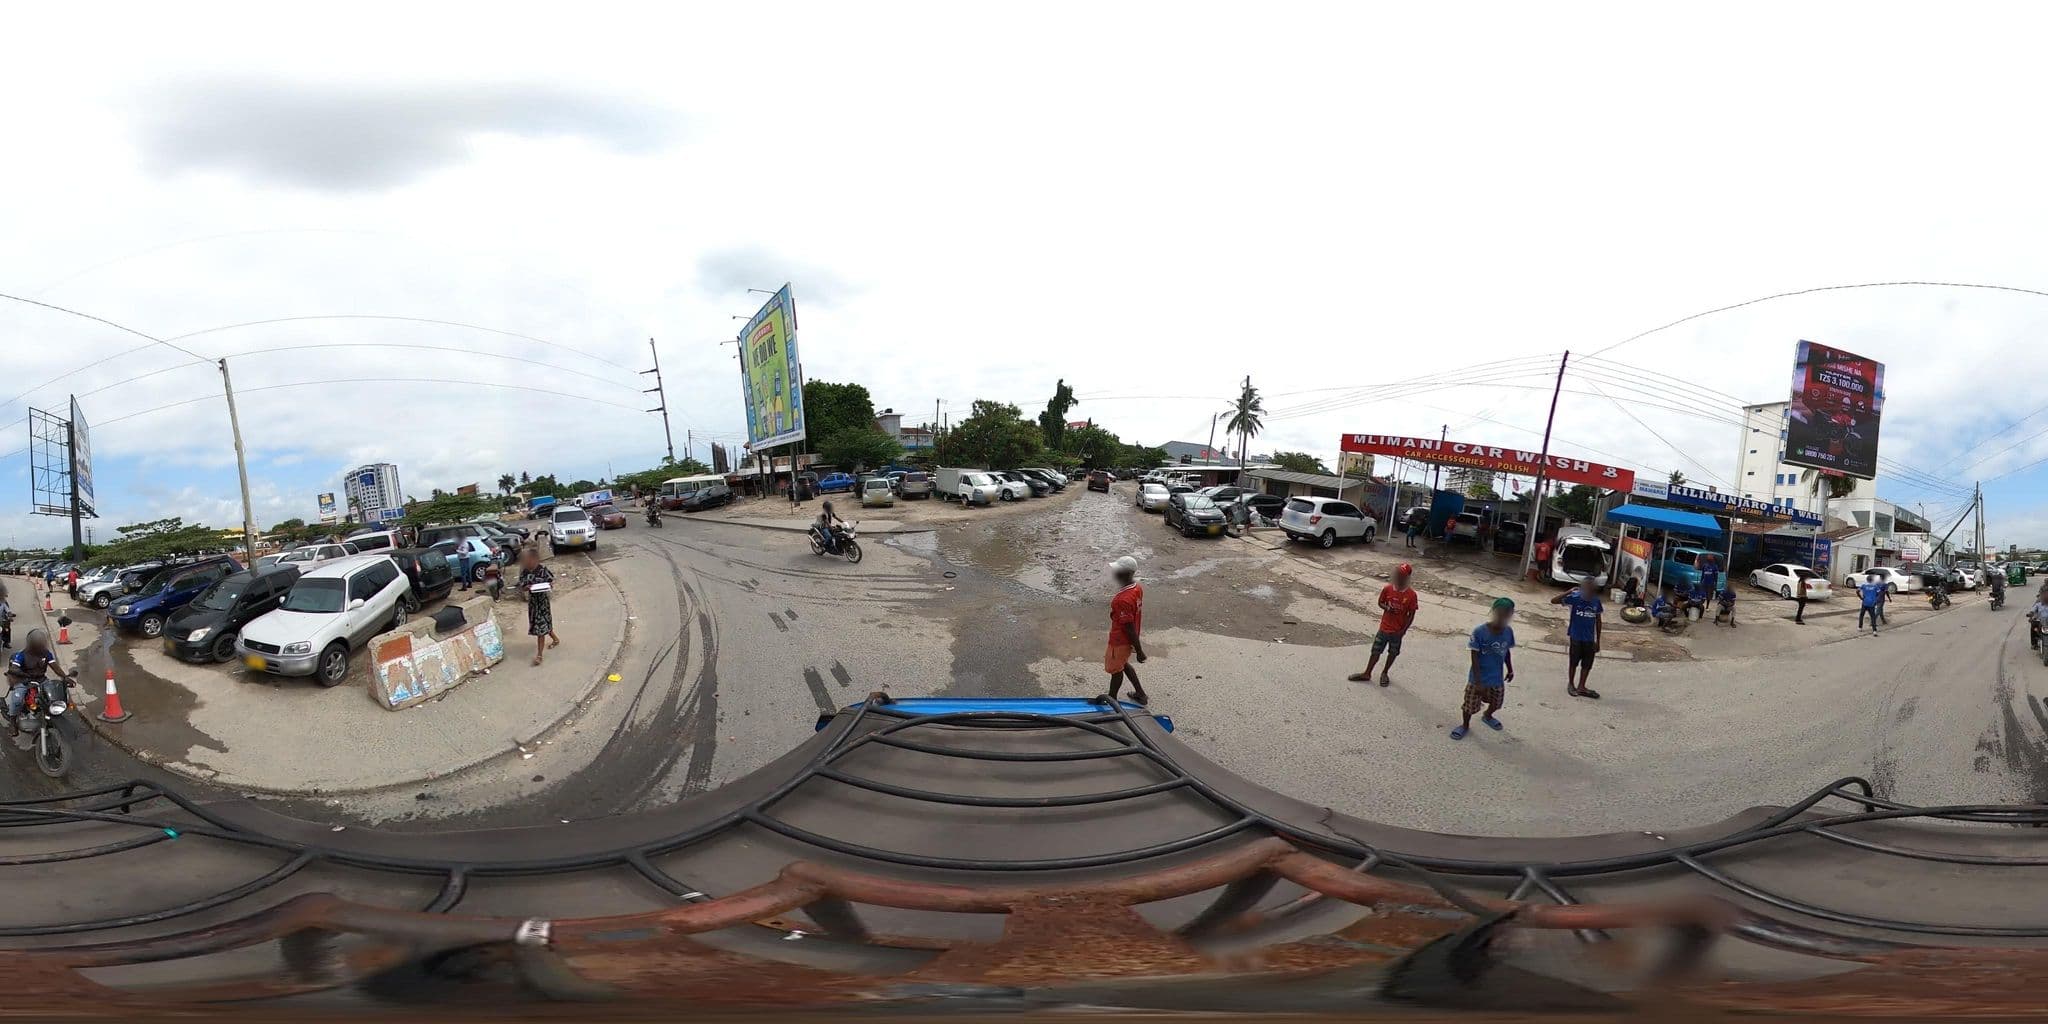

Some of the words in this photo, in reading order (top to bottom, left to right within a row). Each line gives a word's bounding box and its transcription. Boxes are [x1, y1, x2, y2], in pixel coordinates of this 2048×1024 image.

[1819, 373, 1831, 383] TZS
[1353, 434, 1442, 450] MLIMANI
[1453, 443, 1503, 458] CAR
[1515, 451, 1590, 473] WASH
[1603, 467, 1618, 478] &
[1404, 450, 1421, 458] CAR
[1425, 452, 1485, 466] ACCESSORIES
[1497, 462, 1530, 473] POLISH
[1671, 485, 1768, 511] KILIMANJARO
[1772, 505, 1794, 516] CAR
[1798, 510, 1823, 521] WASH
